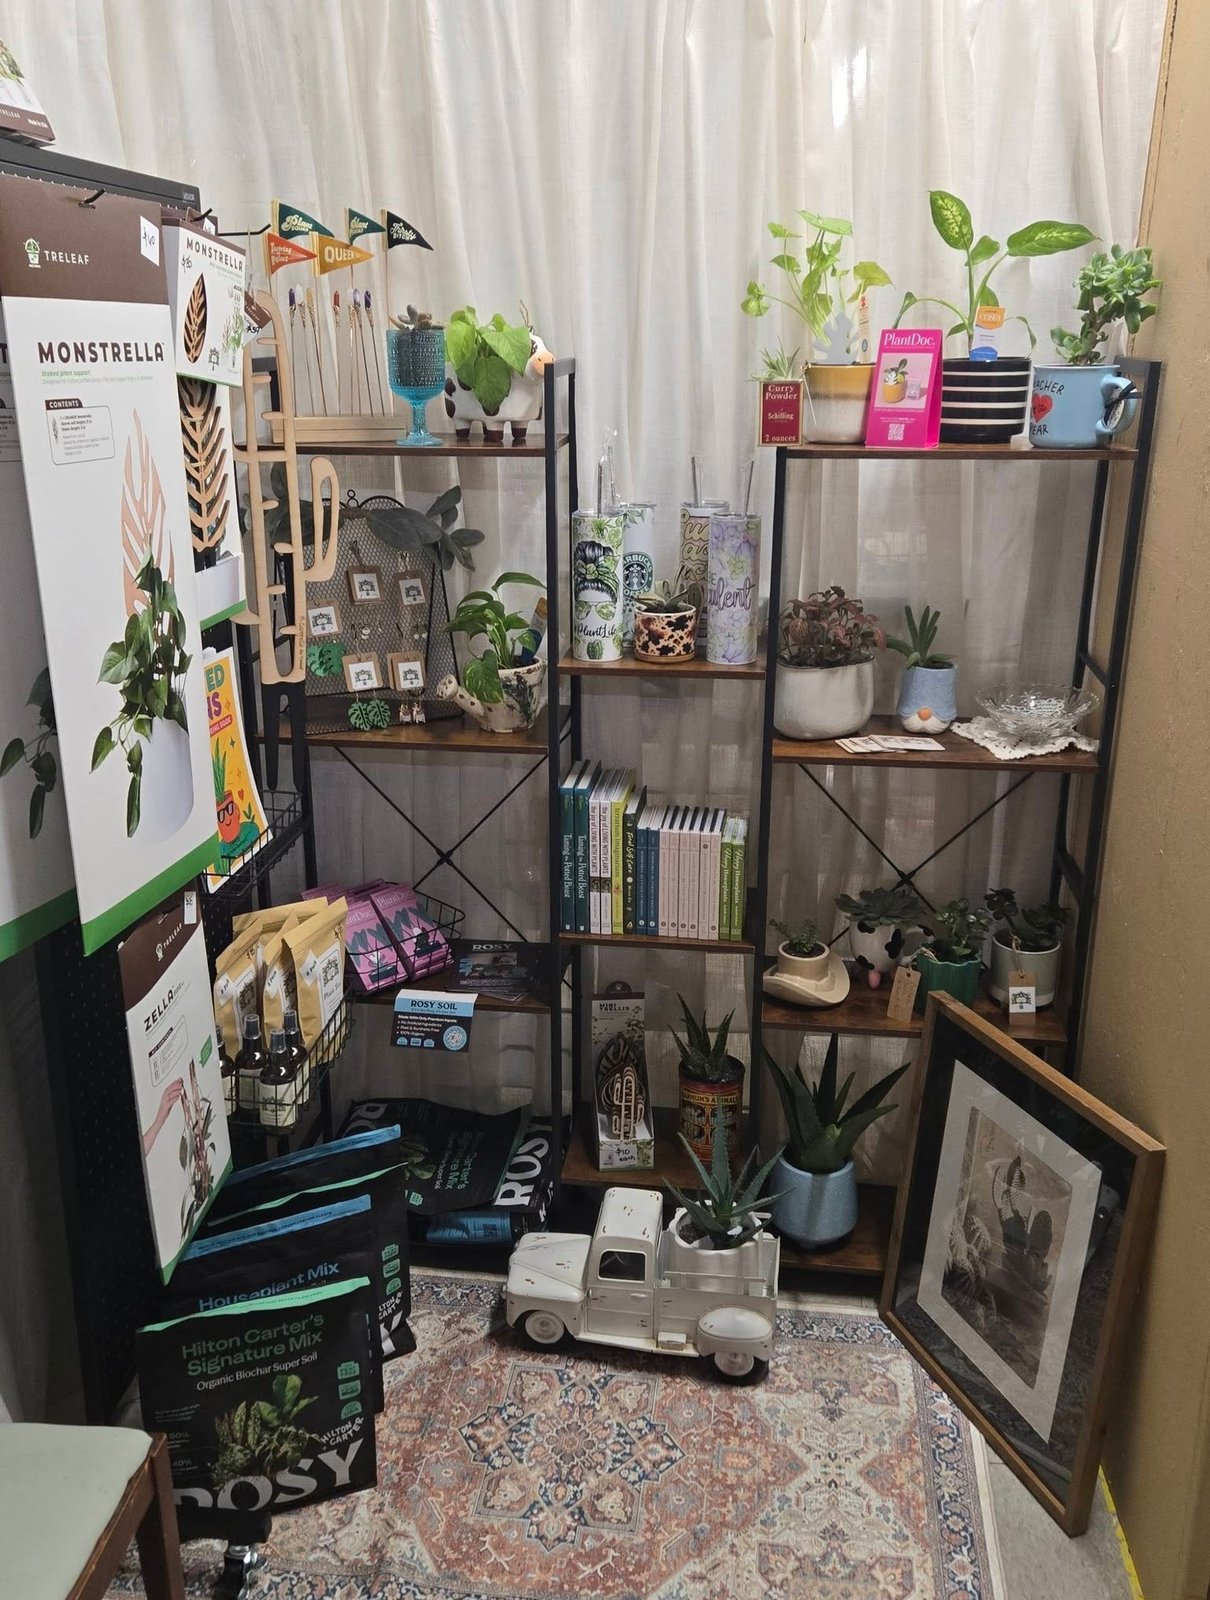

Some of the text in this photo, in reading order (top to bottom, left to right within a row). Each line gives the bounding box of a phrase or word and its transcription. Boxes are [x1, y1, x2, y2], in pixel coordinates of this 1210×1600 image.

[44, 250, 90, 265] TRELEAF
[187, 237, 244, 272] MONSTRELLA
[325, 246, 357, 263] QUEEN
[884, 333, 936, 347] PlantDoc.
[38, 342, 164, 364] MONSTRELLA
[765, 392, 797, 401] Powder
[768, 385, 795, 394] Curry
[49, 400, 79, 409] CONTENTS
[768, 412, 794, 421] Schilling
[589, 814, 597, 822] joy
[600, 814, 608, 822] joy
[563, 834, 572, 856] Taming
[577, 834, 586, 857] Taming
[613, 808, 622, 878] terrarium imaginarium
[563, 862, 572, 881] Potted
[577, 862, 586, 882] Potted
[563, 882, 572, 899] Beast
[577, 882, 586, 899] Beast
[472, 943, 513, 951] ROSY
[144, 989, 174, 1033] ZELLA
[411, 1000, 457, 1010] ROSY SOIL
[616, 1148, 631, 1156] $10
[307, 1262, 339, 1281] Mix
[182, 1314, 325, 1360] Hilton Carter's
[188, 1330, 323, 1376] Signature Mix
[197, 1351, 318, 1391] Organic Biochar Super Soil
[321, 1420, 352, 1445] HILTON
[330, 1416, 364, 1446] CARTER
